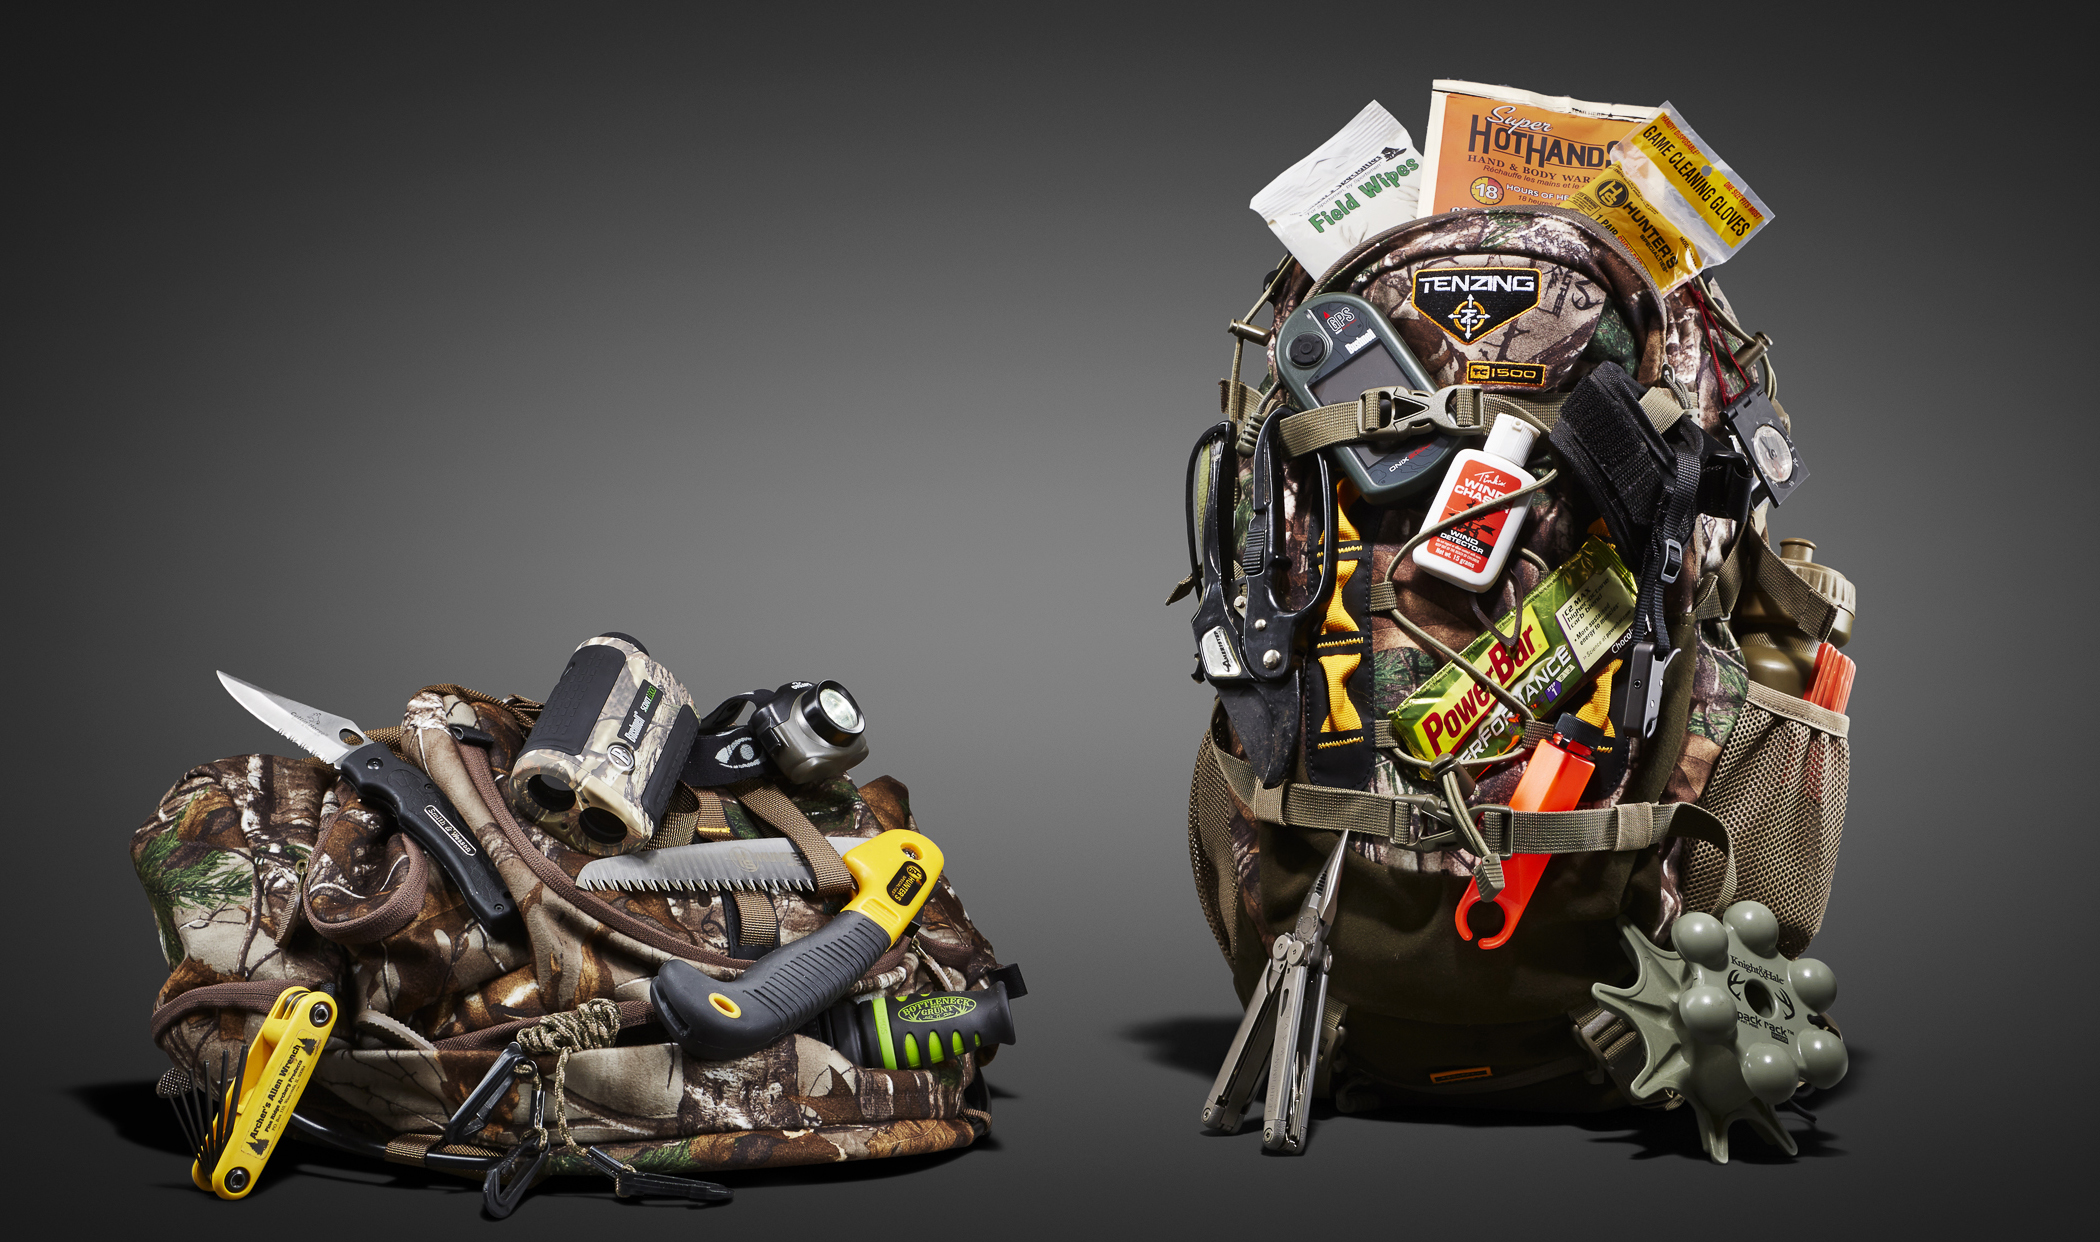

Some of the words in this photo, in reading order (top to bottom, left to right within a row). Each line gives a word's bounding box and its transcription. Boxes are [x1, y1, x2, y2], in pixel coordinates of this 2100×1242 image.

[1486, 105, 1553, 134] Super
[1660, 114, 1676, 131] HANDY!
[1674, 129, 1699, 156] DISPOSABLE!
[1467, 154, 1505, 168] HAND
[1509, 163, 1518, 172] &
[1523, 167, 1557, 180] BODY
[1524, 175, 1535, 184] les
[1537, 178, 1561, 188] mains
[1562, 181, 1571, 189] et
[1643, 124, 1674, 156] GAME
[1668, 151, 1715, 200] CLEANING
[1710, 195, 1750, 236] GLOVES
[1308, 192, 1361, 233] Field
[1358, 158, 1419, 198] Wipes
[1476, 184, 1498, 200] 18
[1506, 184, 1539, 197] HOURS
[1541, 192, 1554, 200] OF
[1747, 206, 1762, 220] MOST
[1622, 201, 1678, 270] HUNTER'S
[1419, 274, 1535, 293] TENZING
[1327, 307, 1355, 331] GPS
[1491, 369, 1537, 378] 1500
[1440, 532, 1484, 554] DETECTOR
[1450, 529, 1479, 546] WIND
[1435, 546, 1444, 555] Net
[1459, 558, 1474, 569] grams
[1572, 587, 1592, 605] MAX
[428, 809, 445, 826] Smith
[902, 997, 970, 1016] BOTTLENECK
[921, 1005, 954, 1016] GRUNT
[1737, 1010, 1762, 1027] pack
[250, 1101, 271, 1139] Archer's
[268, 1078, 284, 1102] Allen
[279, 1044, 301, 1077] Wrench
[270, 1104, 280, 1122] Ridge
[279, 1083, 291, 1105] Archery
